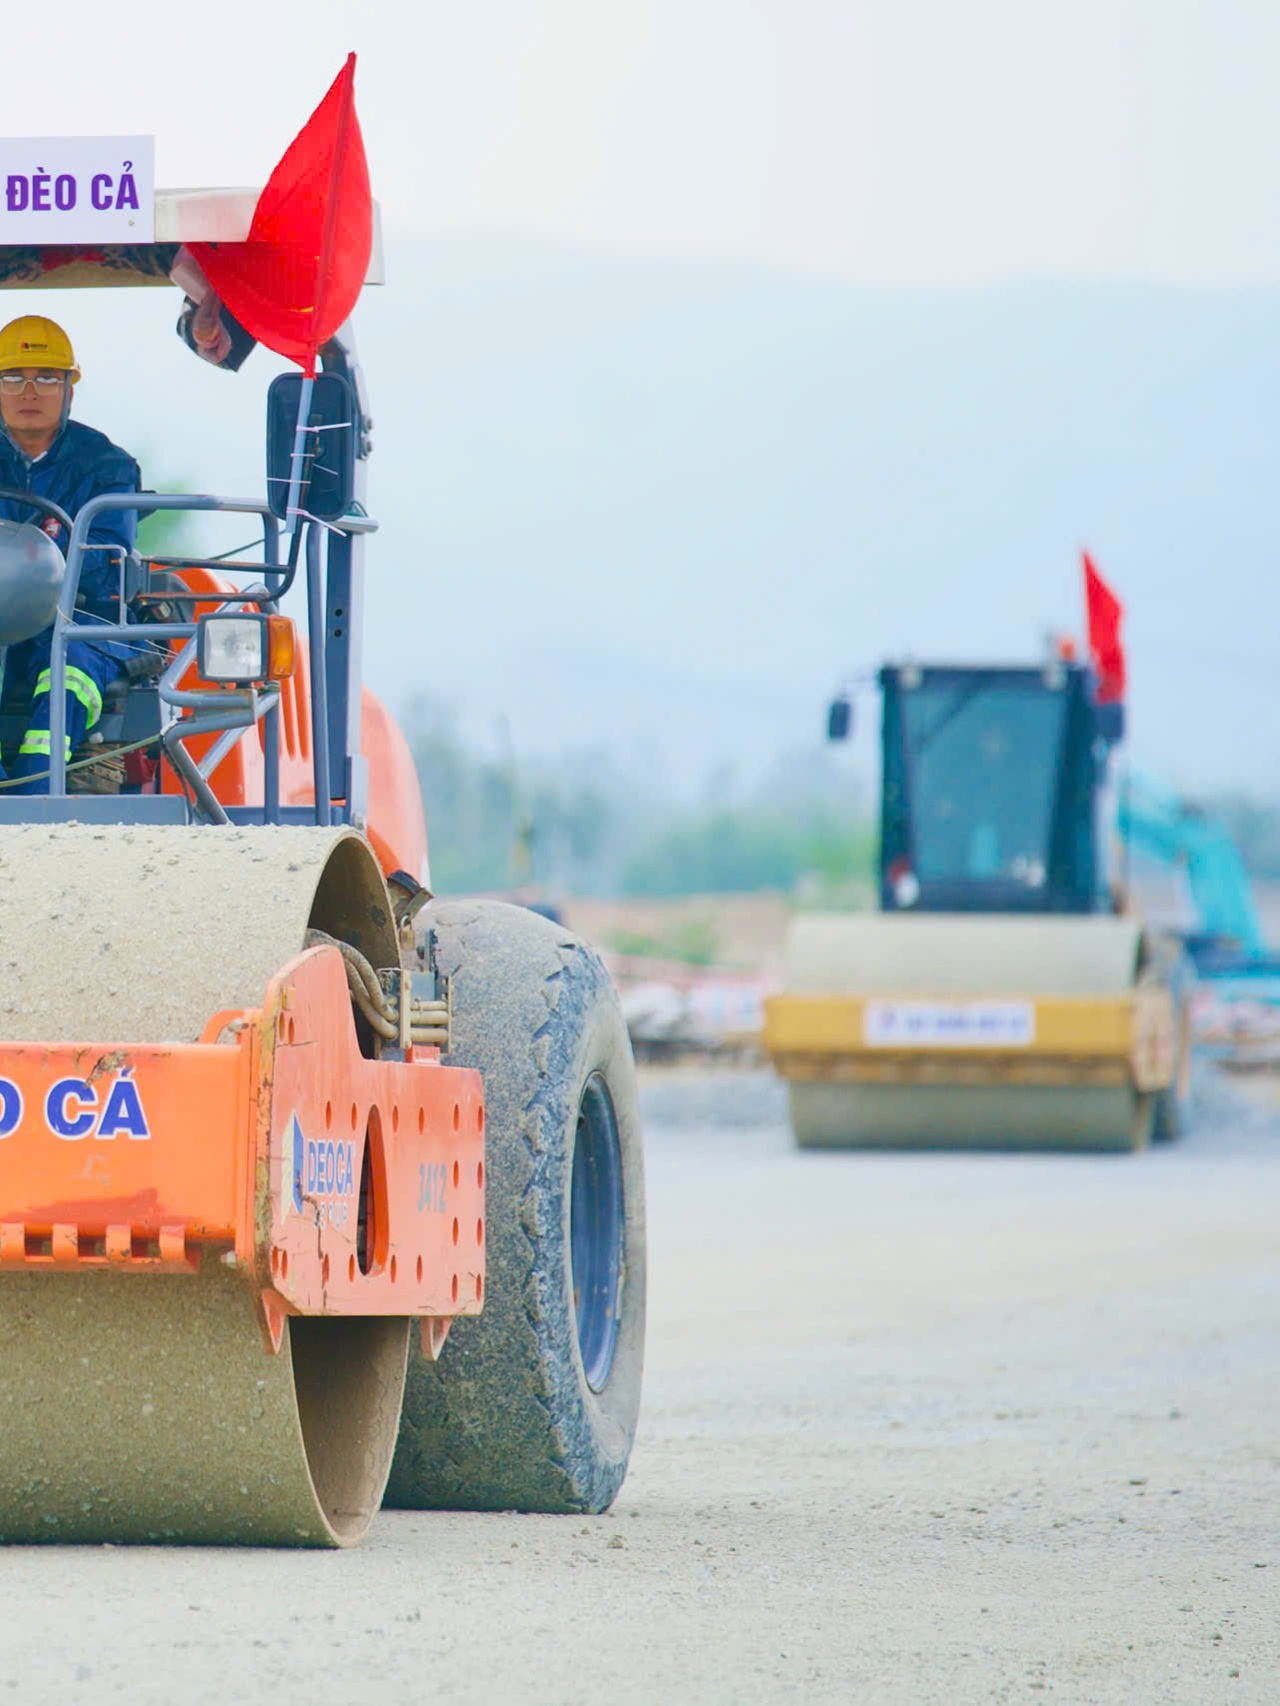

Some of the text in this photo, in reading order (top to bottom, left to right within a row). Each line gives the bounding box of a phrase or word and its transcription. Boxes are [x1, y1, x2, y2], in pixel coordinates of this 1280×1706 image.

[6, 166, 77, 212] ĐÈO
[91, 160, 139, 211] CẢ
[306, 1139, 355, 1197] DEOCA
